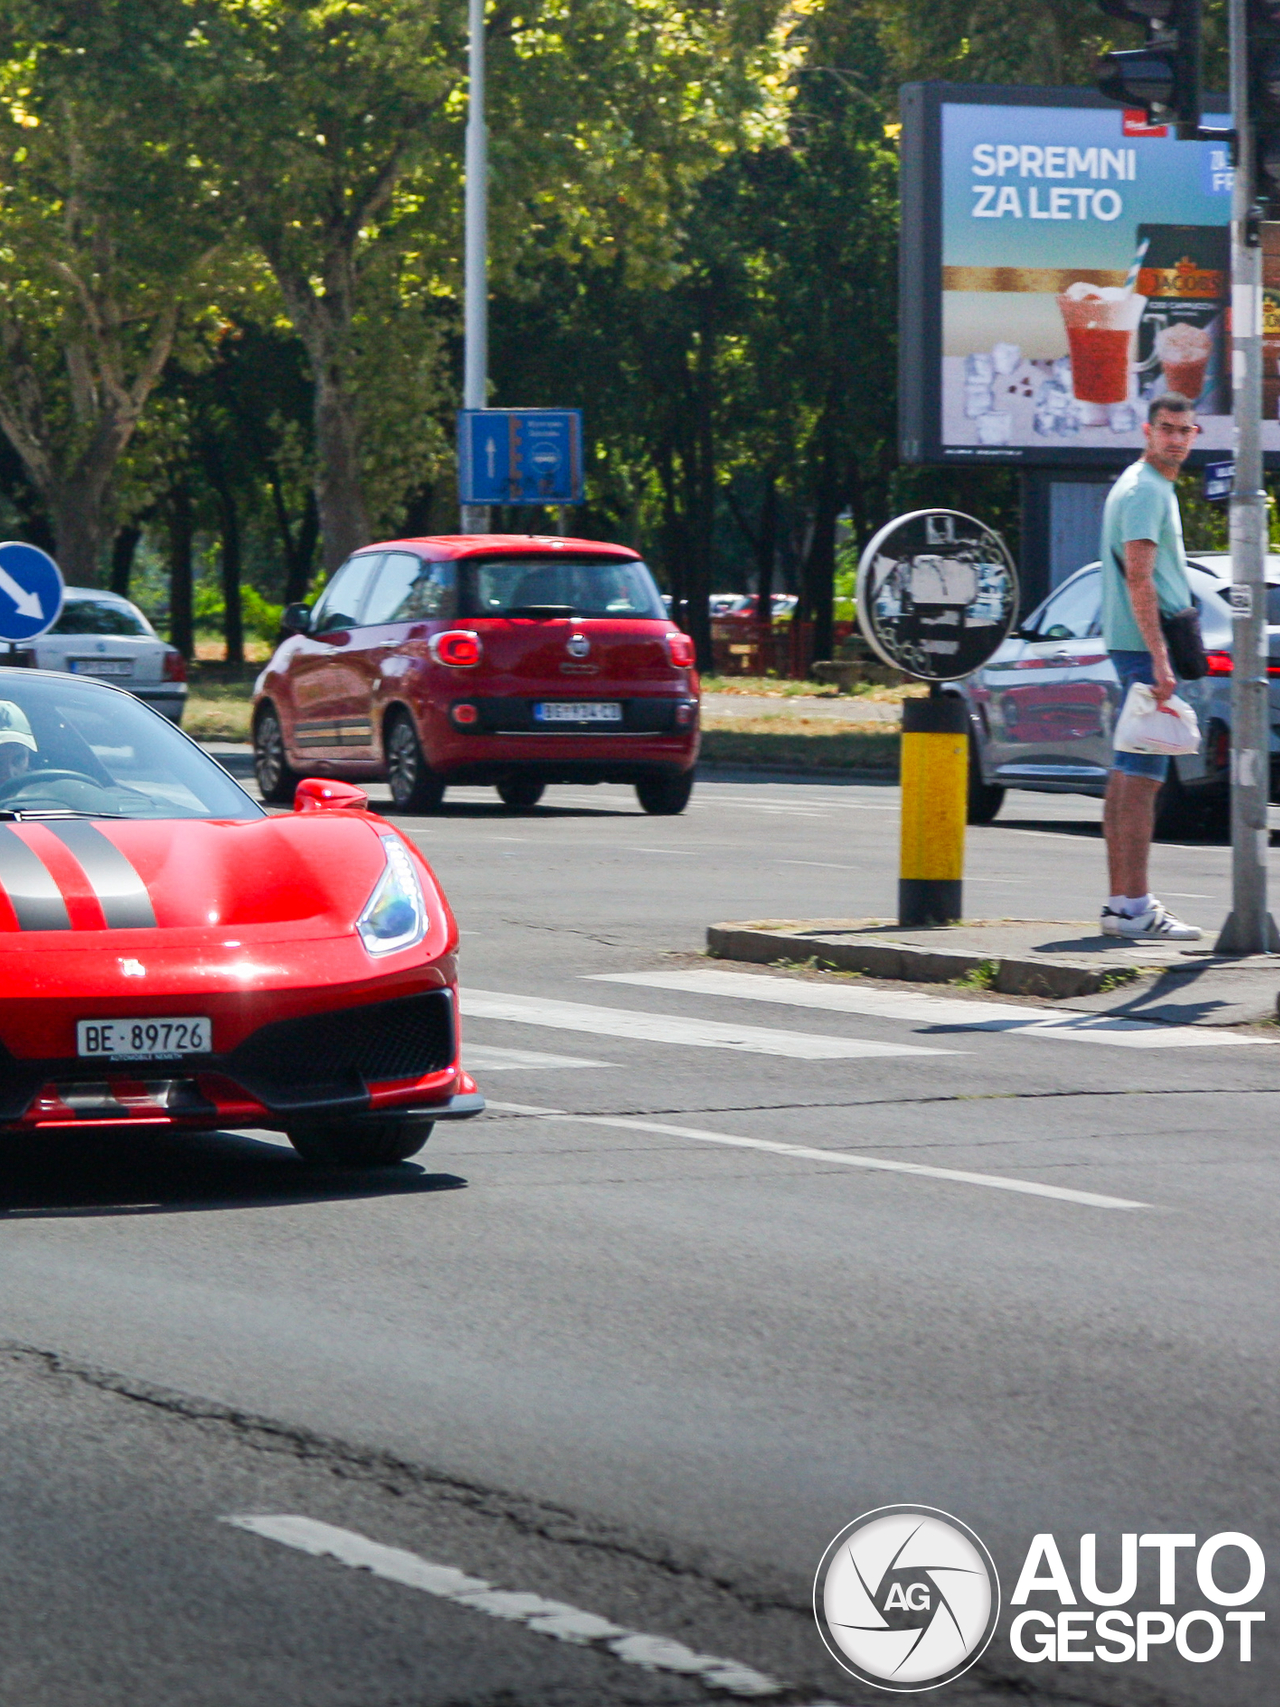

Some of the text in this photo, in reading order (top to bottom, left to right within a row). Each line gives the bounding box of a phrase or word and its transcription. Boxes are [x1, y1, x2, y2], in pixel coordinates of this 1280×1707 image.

[971, 143, 1136, 181] SPREMNI
[971, 185, 1123, 221] ZA LETO
[85, 1023, 203, 1052] BE 89726
